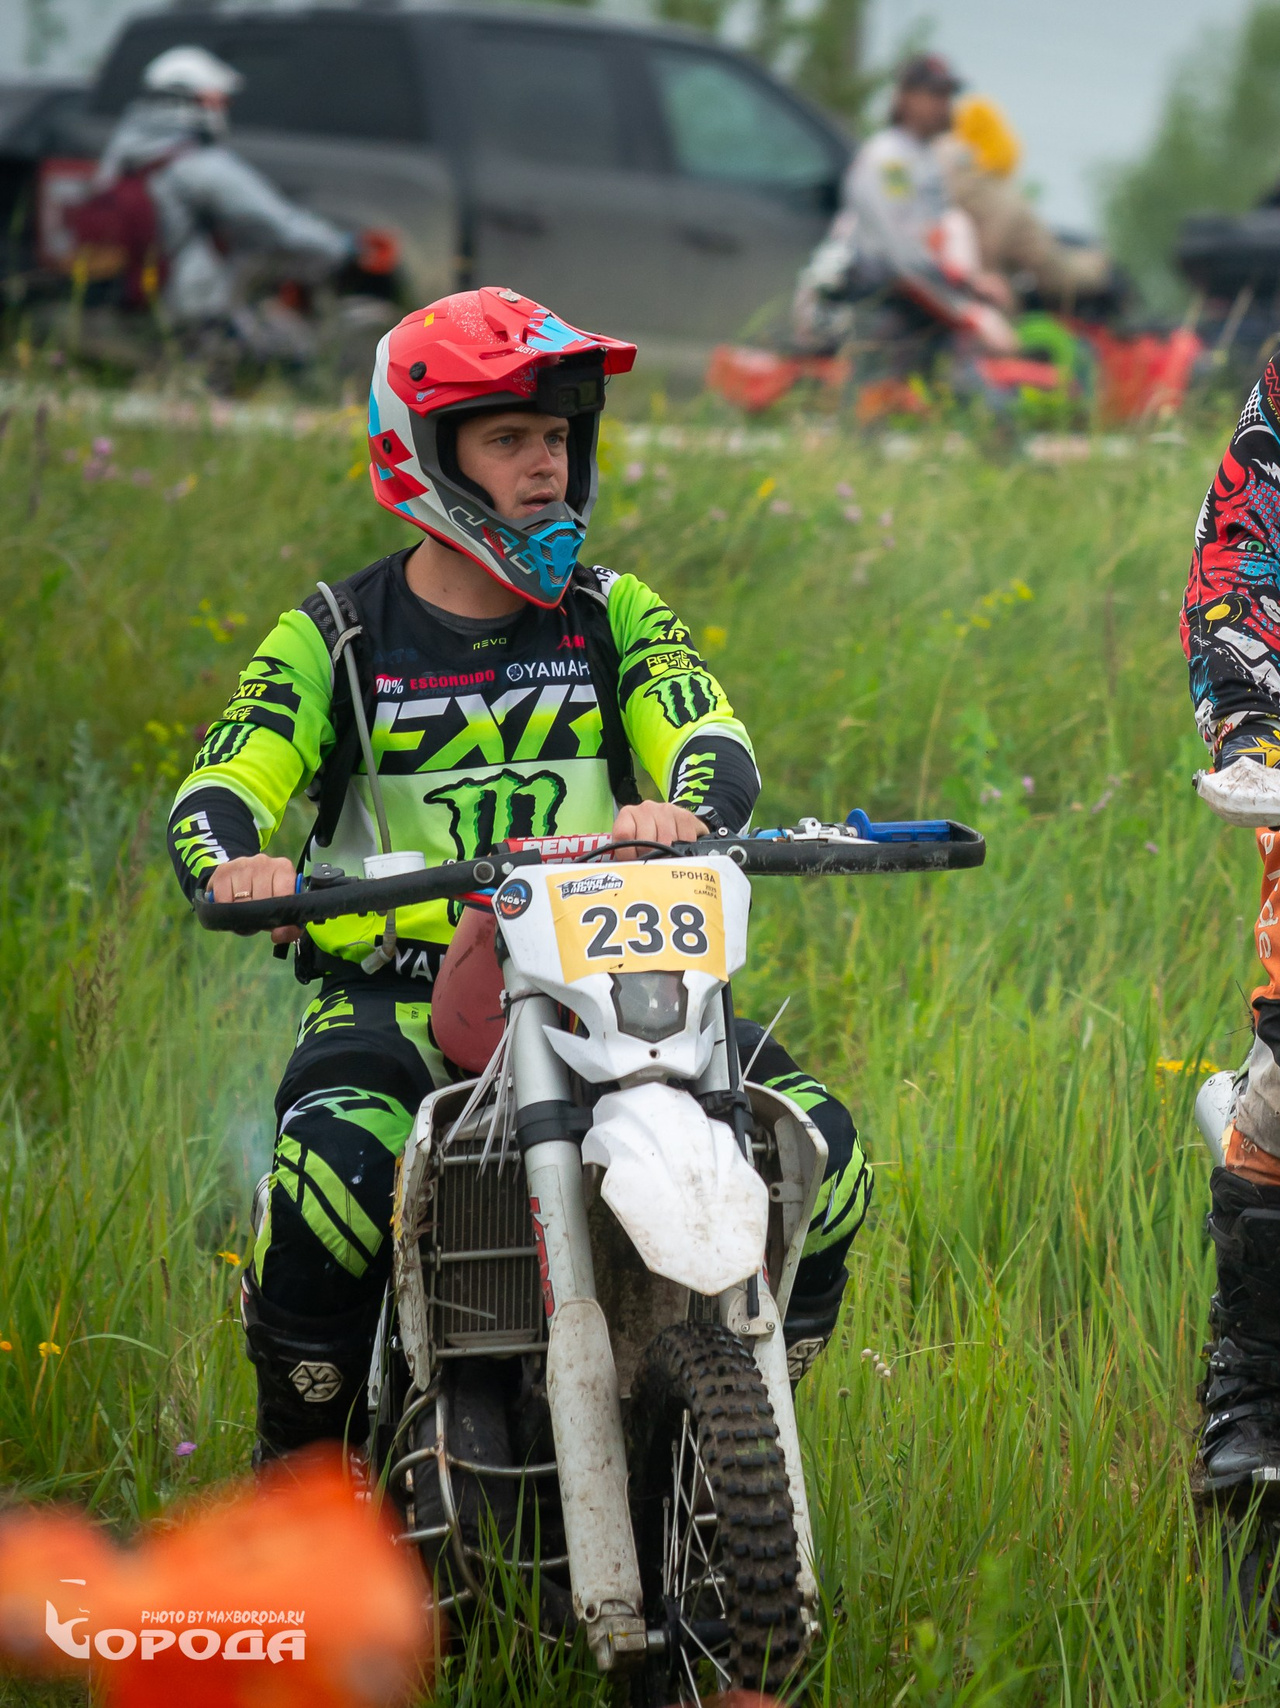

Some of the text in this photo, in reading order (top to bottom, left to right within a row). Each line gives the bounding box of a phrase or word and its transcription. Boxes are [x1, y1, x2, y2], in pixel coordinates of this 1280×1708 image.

[523, 659, 591, 679] YAMAH
[409, 669, 496, 691] ESCONDIDO
[522, 835, 613, 856] RENTH
[670, 870, 717, 884] БРОНЗА
[499, 894, 527, 906] MOST
[580, 902, 709, 960] 238
